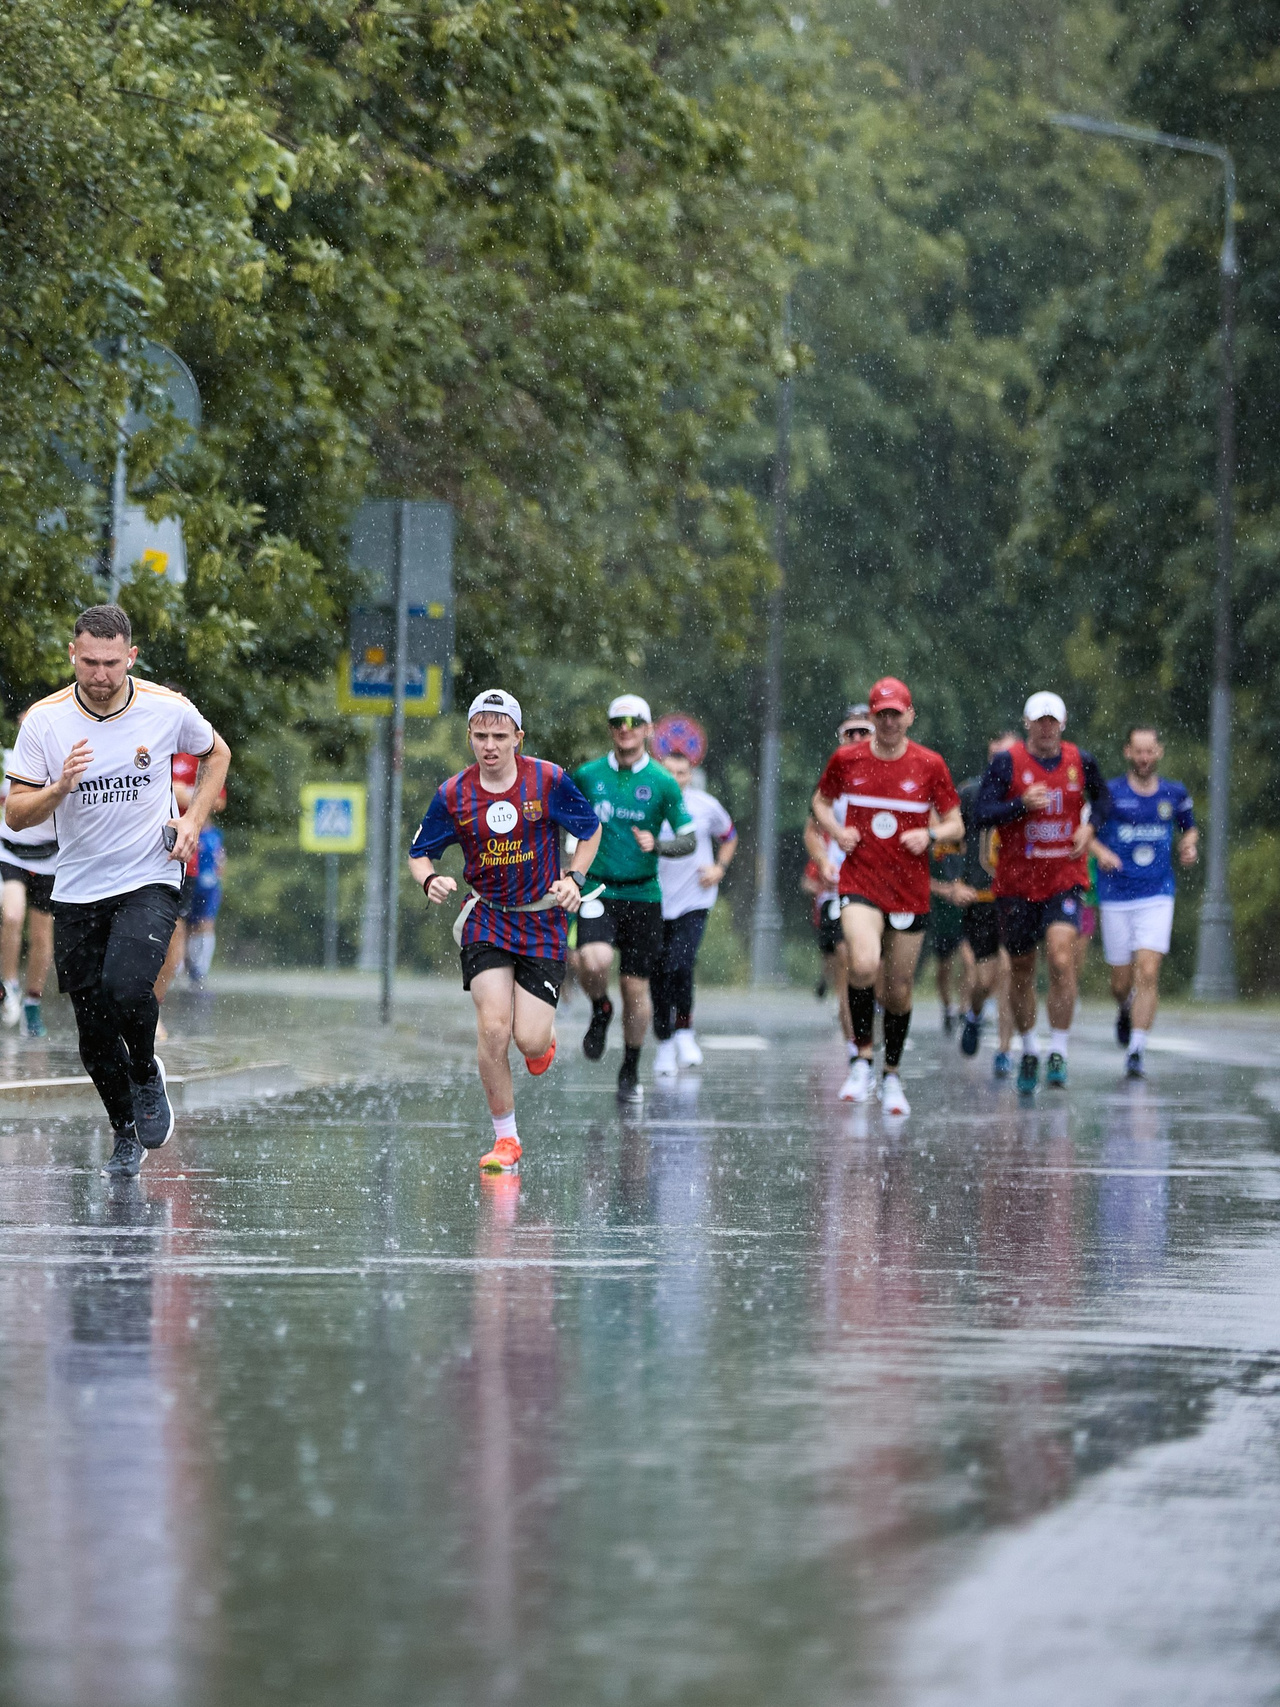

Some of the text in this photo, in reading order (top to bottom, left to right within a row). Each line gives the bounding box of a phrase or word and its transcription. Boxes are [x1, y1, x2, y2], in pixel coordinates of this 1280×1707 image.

[70, 774, 151, 794] mirates
[82, 789, 139, 805] FLY BETTER
[492, 813, 513, 823] 1119
[487, 838, 523, 856] Qatar
[479, 850, 534, 868] Foundation
